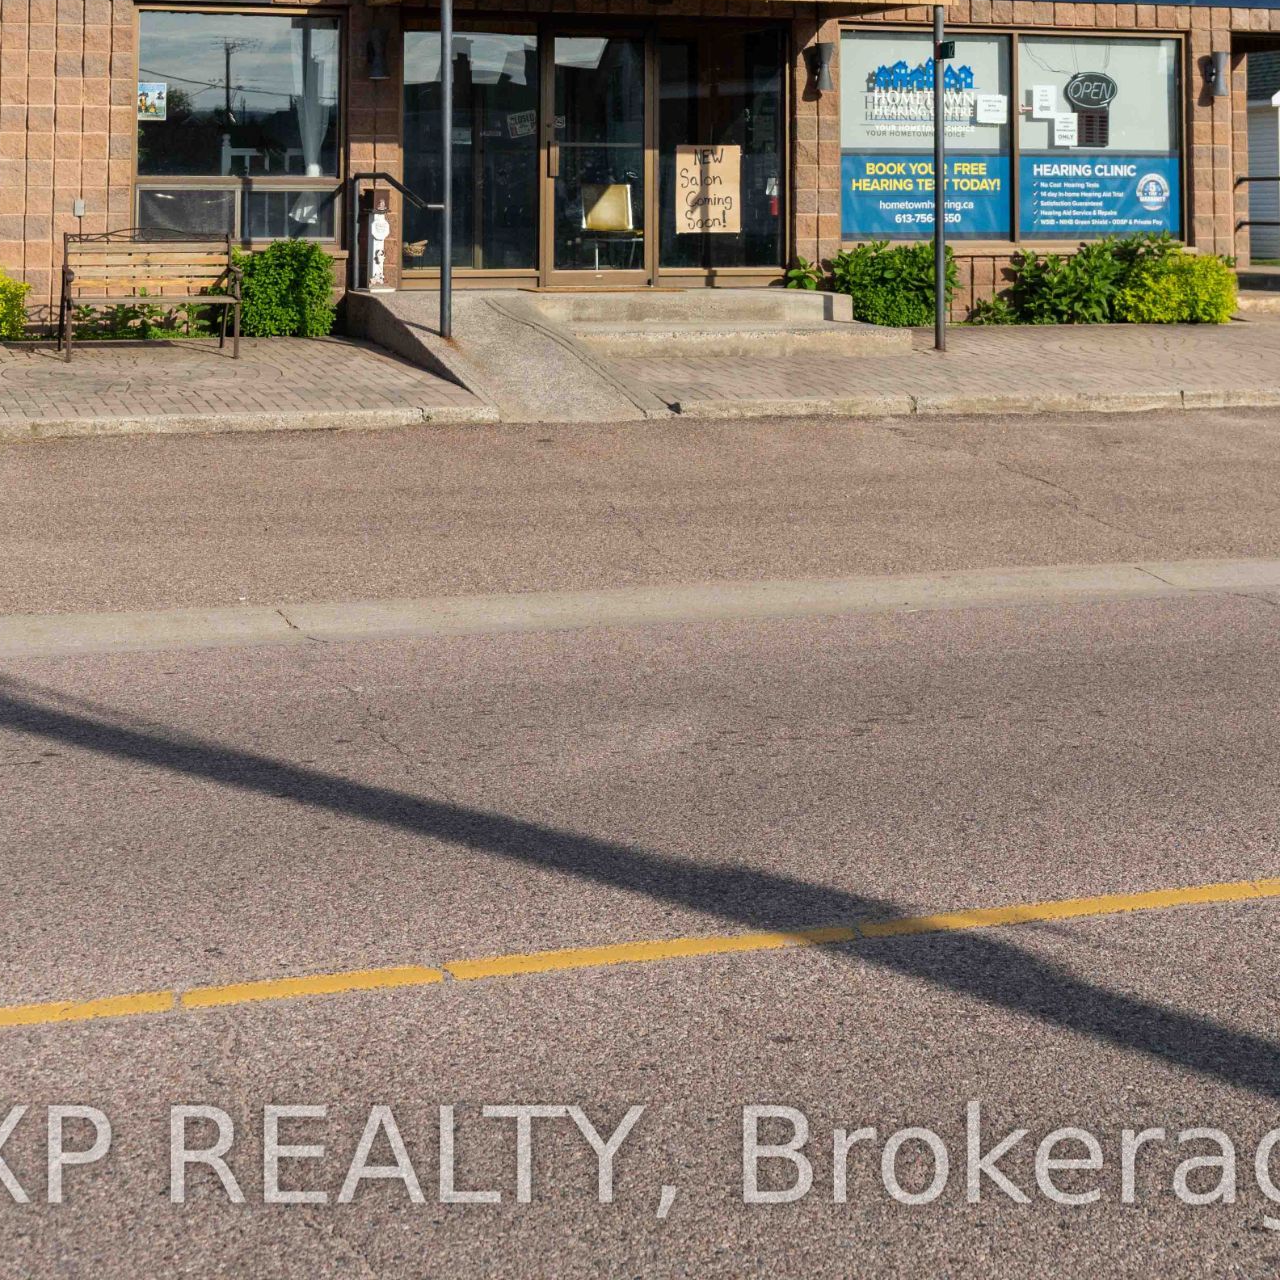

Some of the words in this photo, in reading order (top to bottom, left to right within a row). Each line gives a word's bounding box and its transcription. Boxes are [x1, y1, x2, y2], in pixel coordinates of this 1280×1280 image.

[874, 90, 975, 106] HOMETWN
[1070, 81, 1113, 99] OPEN
[929, 107, 975, 117] CNTRE
[694, 148, 724, 166] NEW
[866, 163, 906, 175] BOOK
[954, 163, 987, 175] FREE
[1033, 164, 1092, 177] HEARING
[1094, 164, 1137, 177] CLINIC
[680, 168, 723, 188] Salon
[851, 178, 913, 191] HEARING
[916, 179, 950, 191] TET
[952, 179, 1001, 191] TODAY!
[686, 191, 733, 211] Coming
[685, 209, 727, 230] Soon!
[895, 213, 962, 224] 613-756-550
